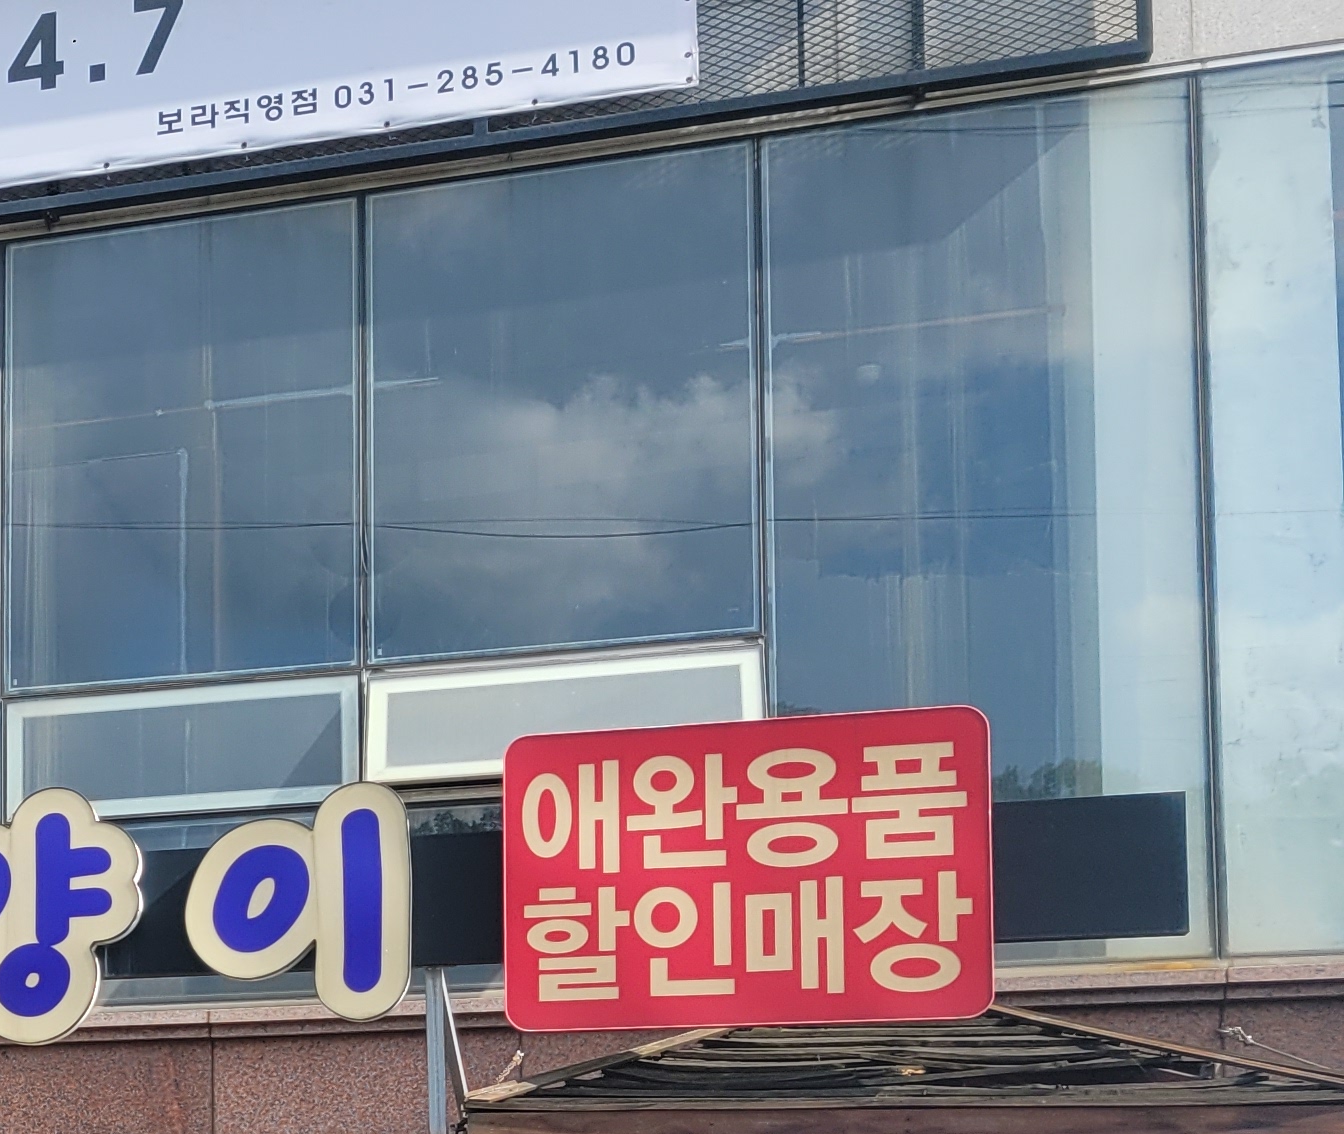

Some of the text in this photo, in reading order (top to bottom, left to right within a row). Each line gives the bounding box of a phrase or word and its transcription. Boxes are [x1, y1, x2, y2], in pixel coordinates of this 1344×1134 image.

[155, 40, 640, 138] 보라직영점 031-285-4180
[521, 740, 968, 873] 애완용품
[523, 870, 974, 1003] 할인매장
